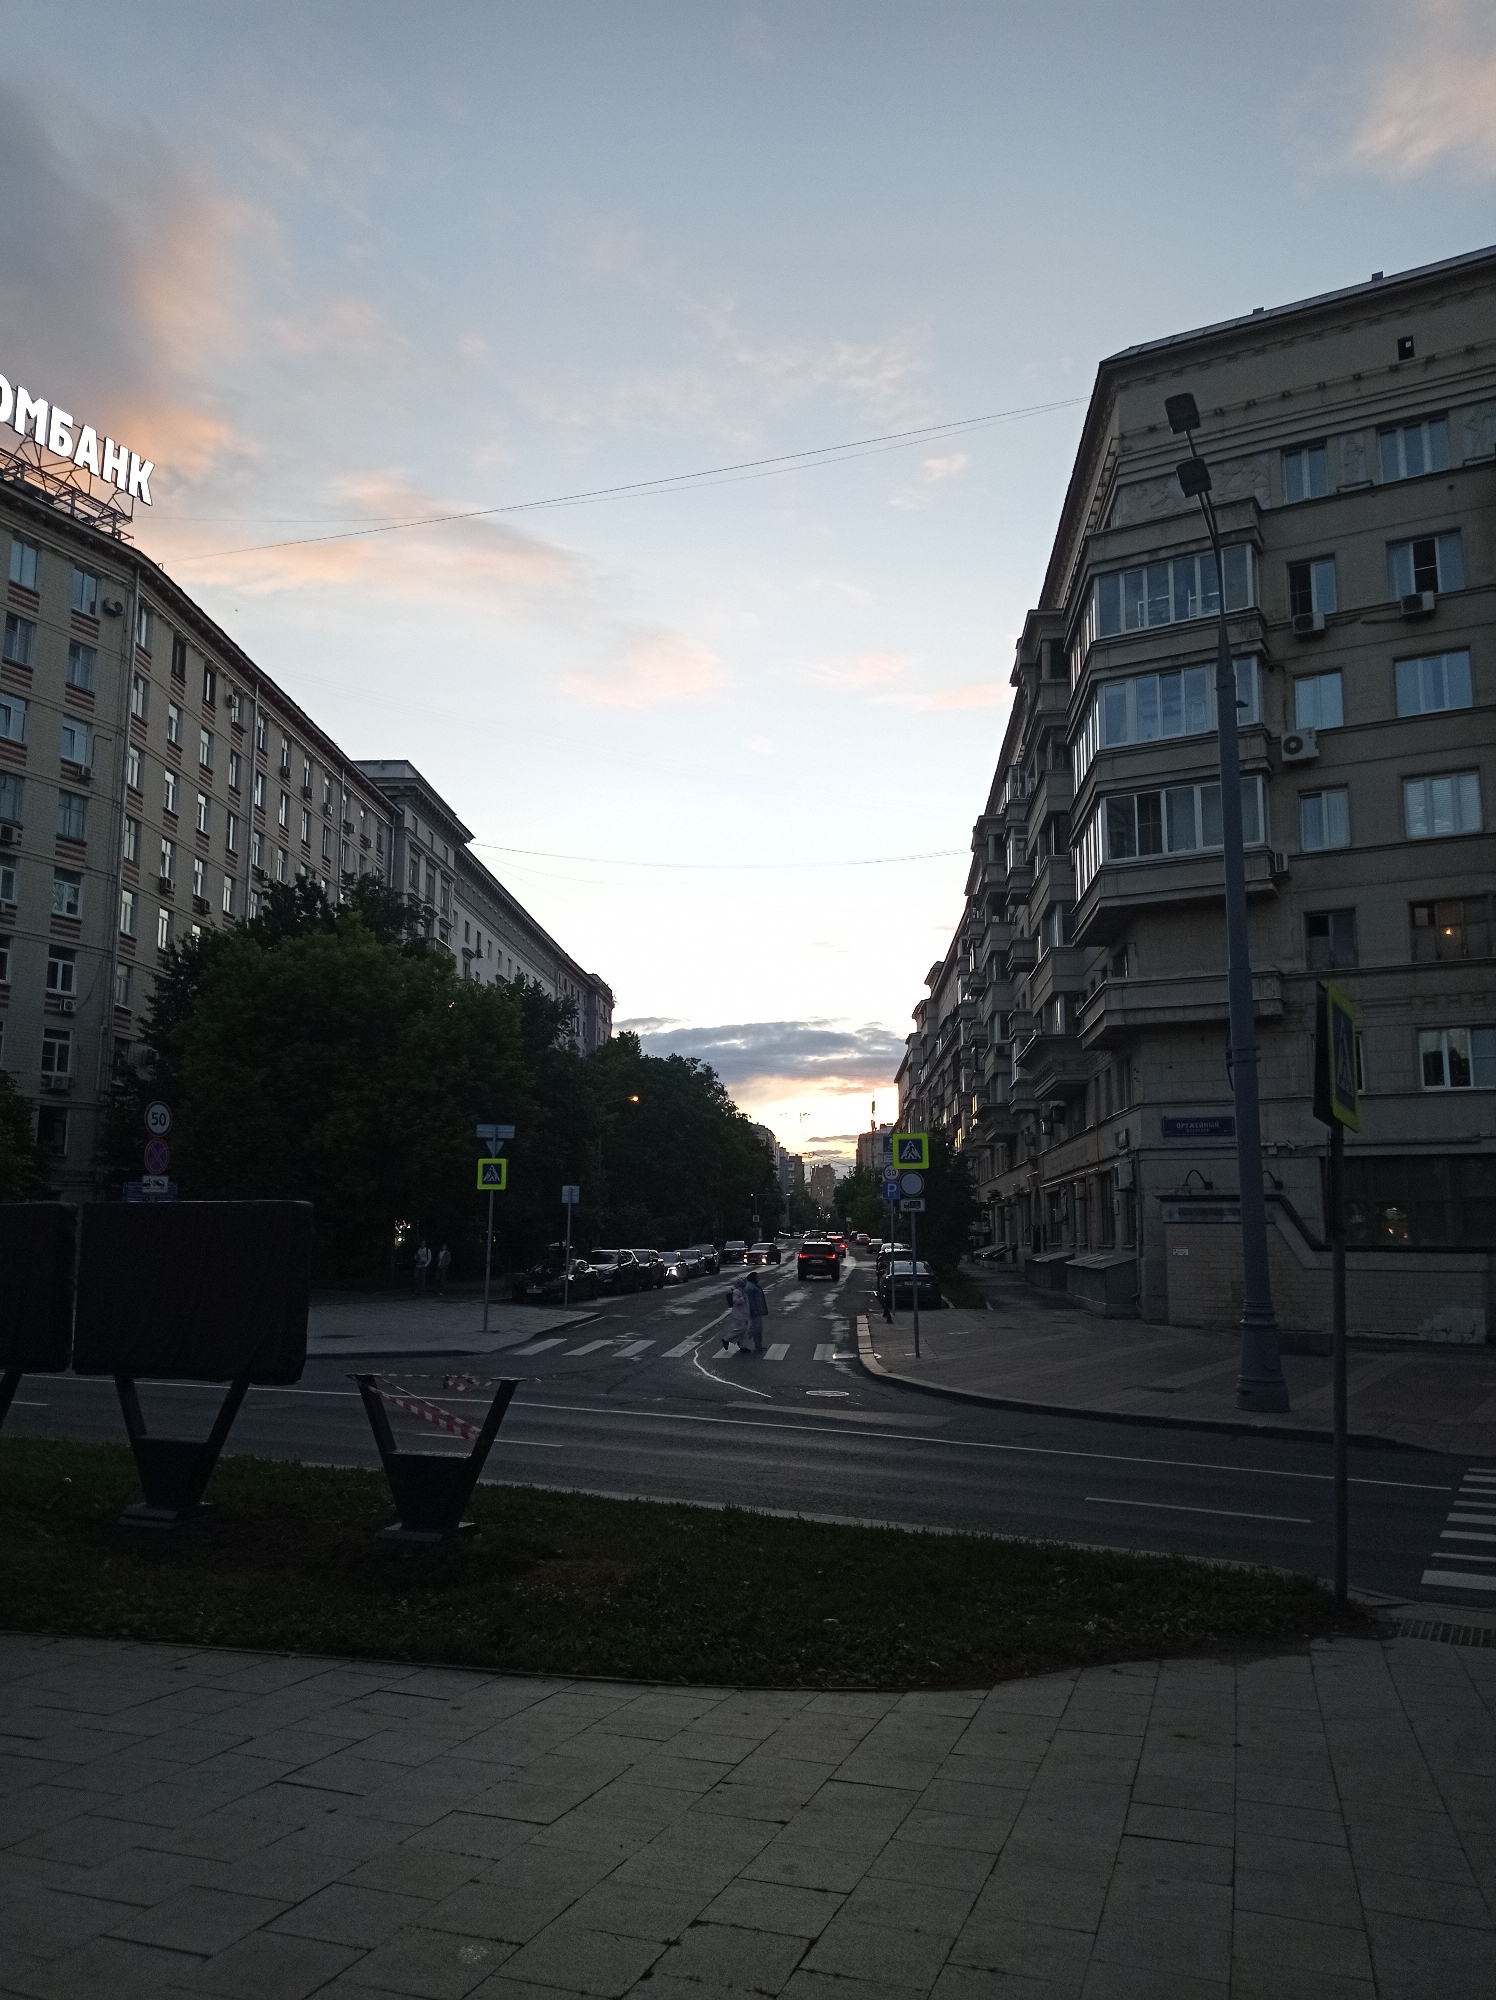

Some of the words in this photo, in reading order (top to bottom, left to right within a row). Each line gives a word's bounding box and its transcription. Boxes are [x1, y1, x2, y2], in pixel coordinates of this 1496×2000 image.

[151, 1112, 167, 1126] 50
[1176, 1121, 1220, 1129] ОРУЖЕЙНЫЙ
[886, 1169, 897, 1177] 30
[887, 1183, 897, 1197] P
